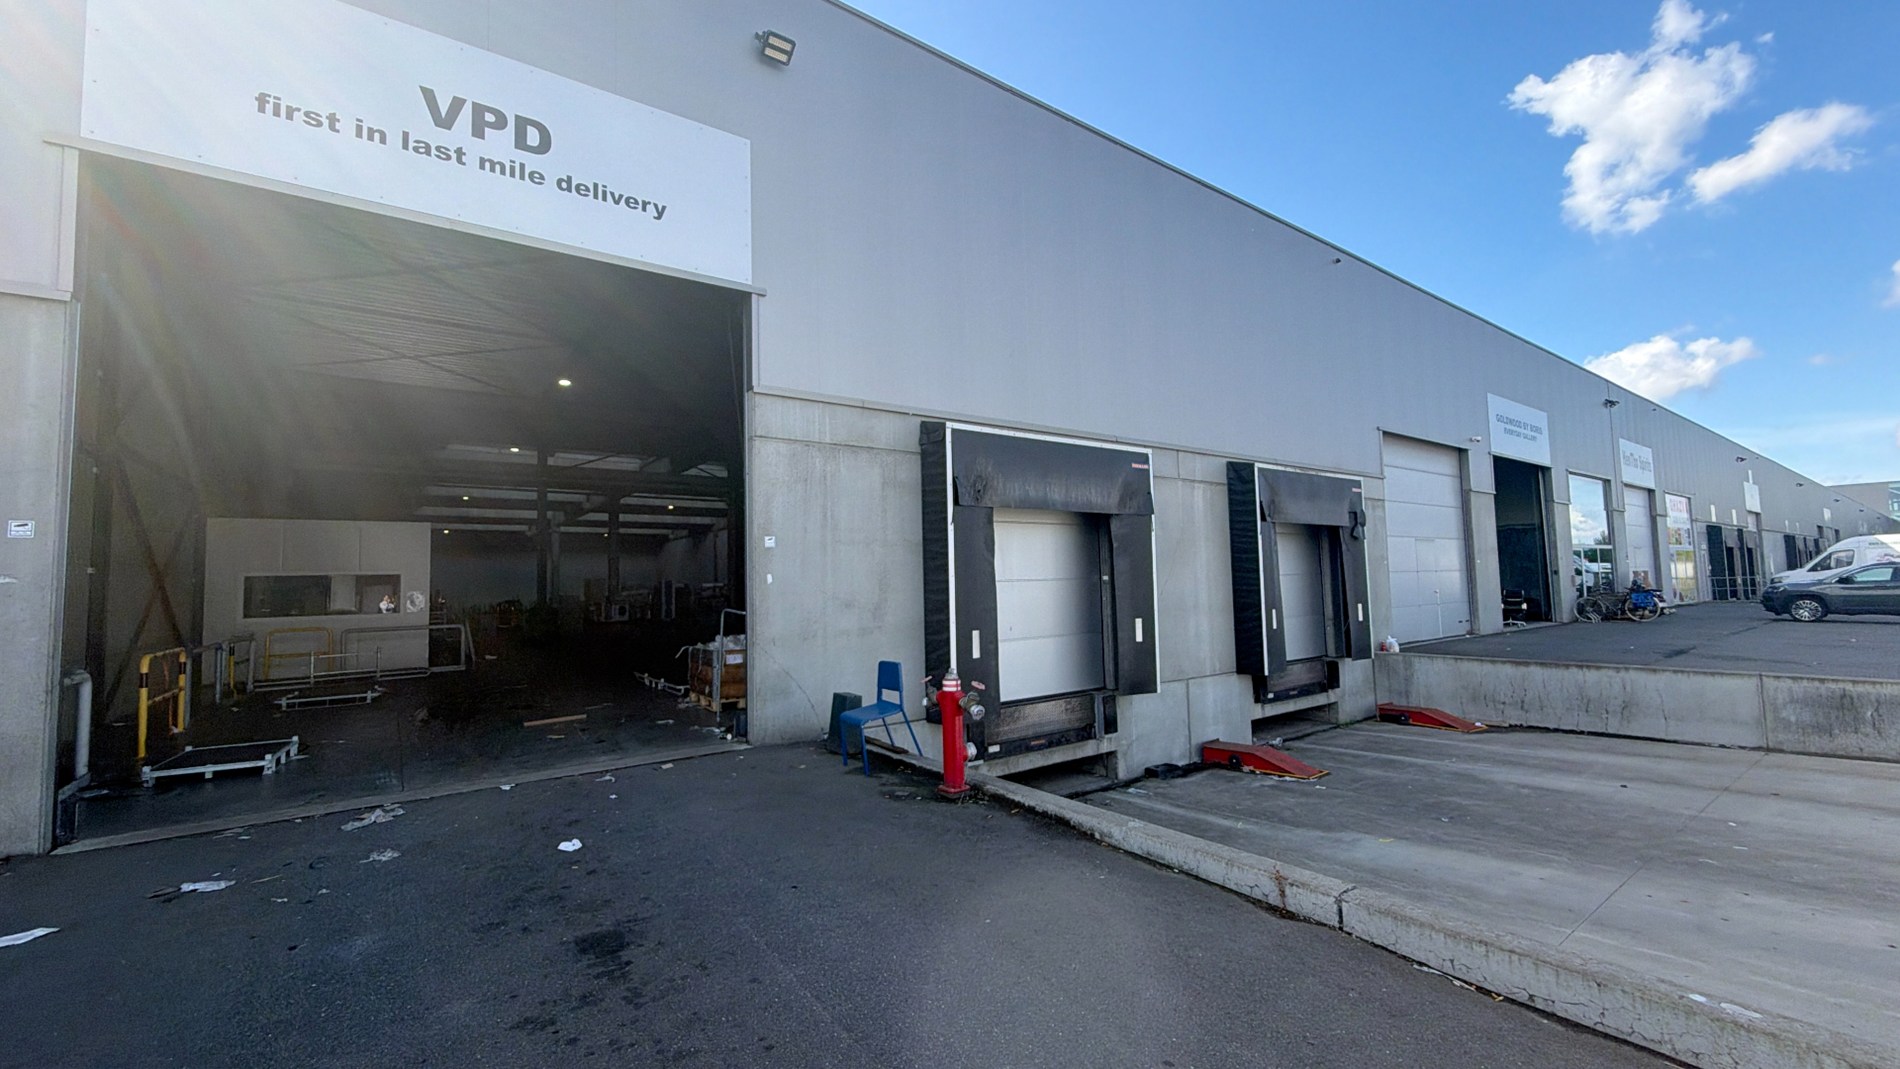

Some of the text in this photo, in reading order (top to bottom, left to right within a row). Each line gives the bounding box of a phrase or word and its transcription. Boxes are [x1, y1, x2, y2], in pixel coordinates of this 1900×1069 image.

[255, 92, 667, 220] first in last mile delivery
[419, 85, 552, 155] VPD
